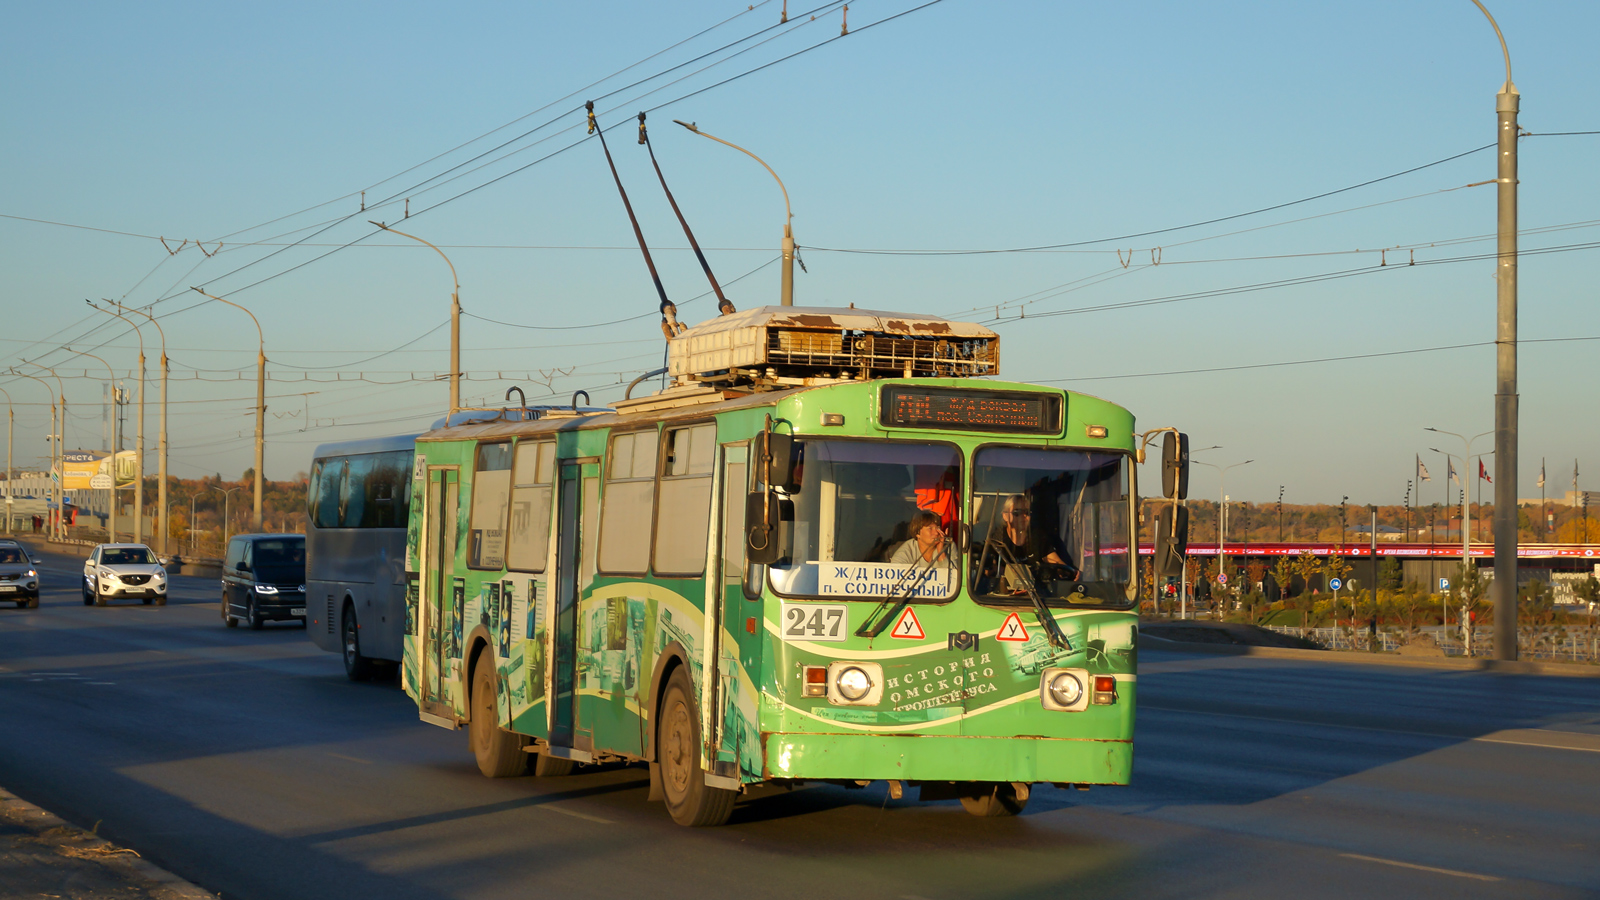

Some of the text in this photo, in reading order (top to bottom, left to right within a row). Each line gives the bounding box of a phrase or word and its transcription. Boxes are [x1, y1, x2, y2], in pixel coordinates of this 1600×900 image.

[834, 566, 938, 582] Ж/Д ВОКЗАЛ
[1442, 579, 1449, 588] P
[845, 581, 947, 597] СОЛНЕЧНЫЙ
[786, 608, 844, 637] 247
[887, 652, 991, 689] ИСТОРИЯ
[890, 667, 994, 703] ОМСКОГО
